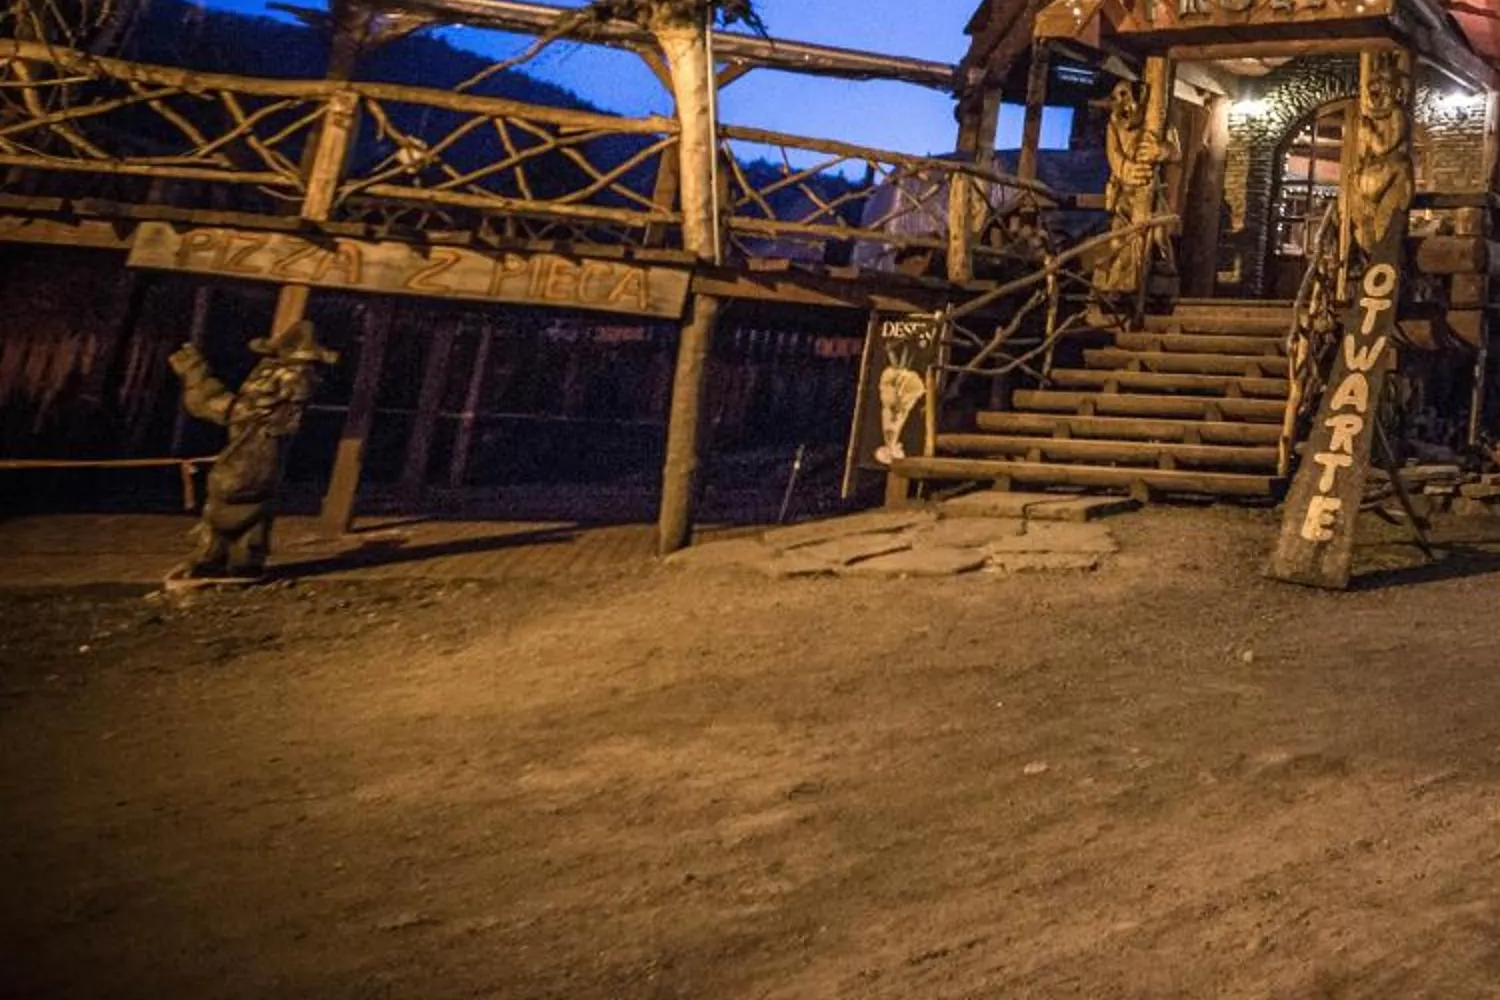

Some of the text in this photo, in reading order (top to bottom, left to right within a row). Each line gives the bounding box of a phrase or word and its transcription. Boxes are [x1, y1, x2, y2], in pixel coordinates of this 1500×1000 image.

[175, 229, 656, 311] PIZZA Z PIECA
[1301, 263, 1396, 542] OTWARTE
